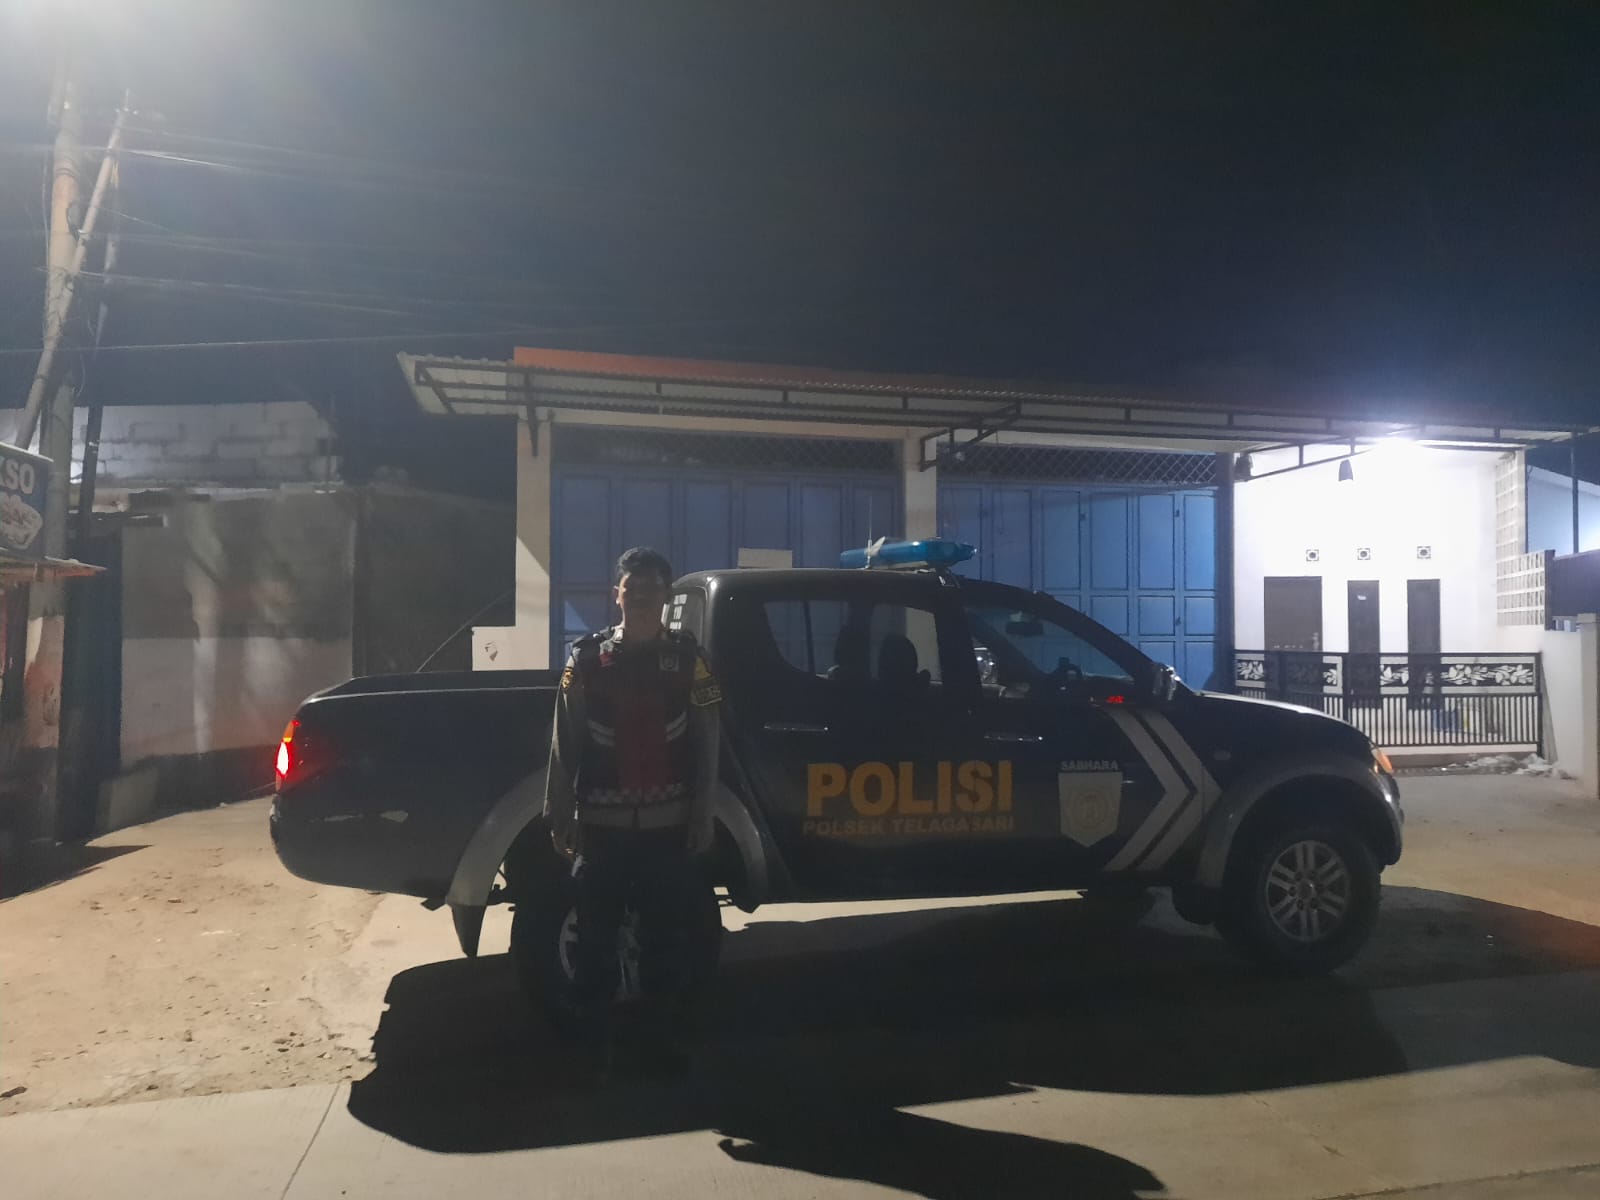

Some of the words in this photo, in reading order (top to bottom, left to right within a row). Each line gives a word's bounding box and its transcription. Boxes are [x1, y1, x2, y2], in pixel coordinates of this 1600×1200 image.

[1060, 760, 1119, 770] SABHARA
[807, 760, 1013, 816] POLISI
[802, 819, 884, 836] POLSEK
